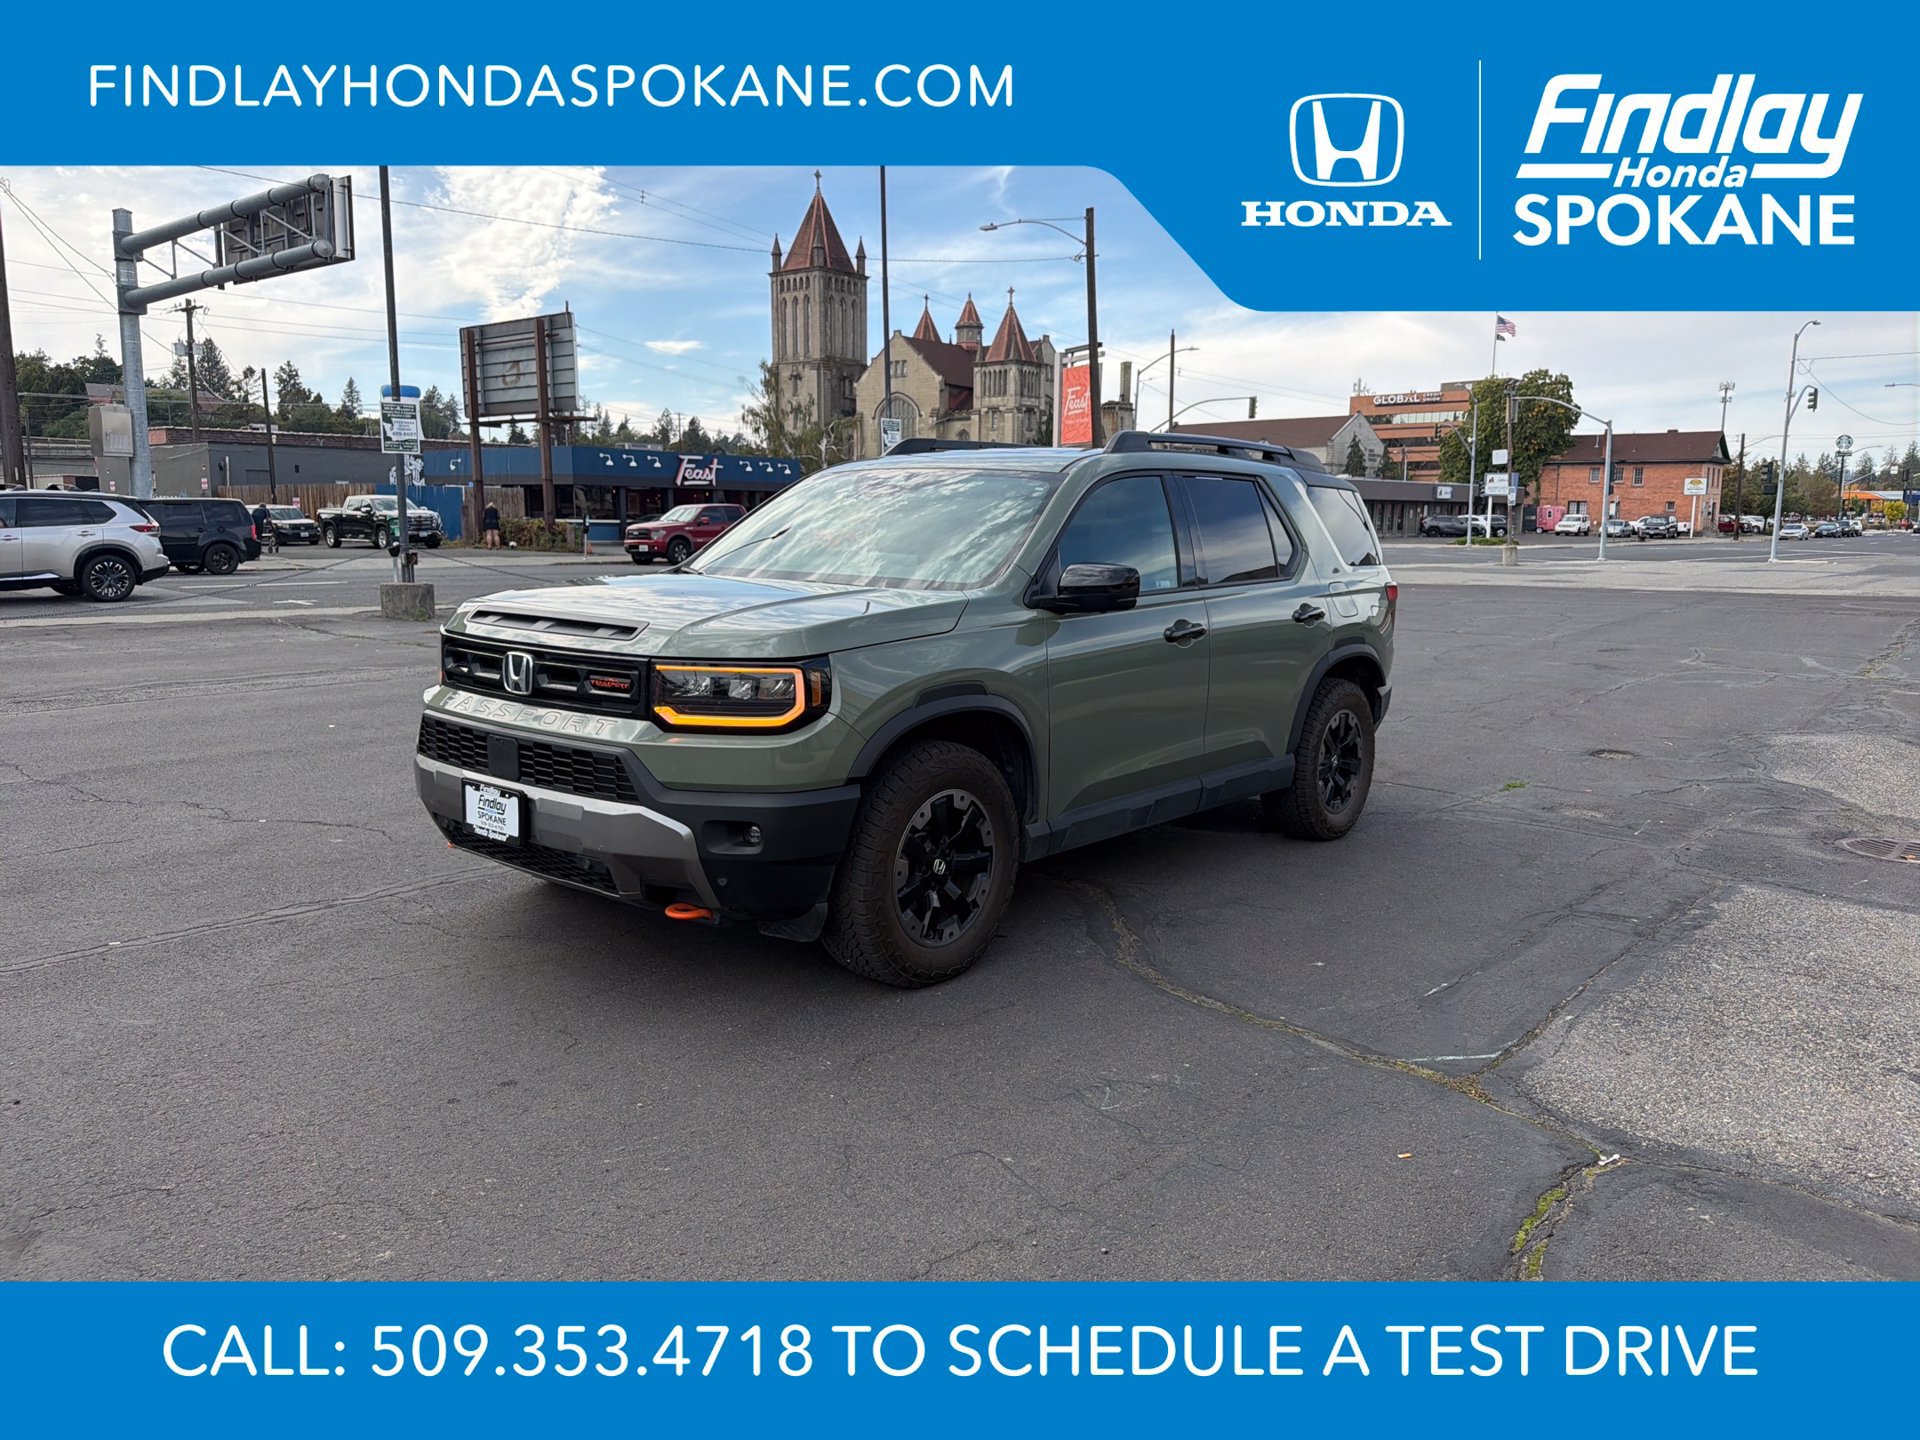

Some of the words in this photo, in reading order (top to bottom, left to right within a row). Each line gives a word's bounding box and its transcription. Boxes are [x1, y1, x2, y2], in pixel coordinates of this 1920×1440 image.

[1064, 387, 1090, 417] Feast
[1373, 394, 1420, 405] GLOBAL
[675, 454, 724, 487] Feast
[477, 794, 507, 816] Findlay
[477, 810, 507, 826] SPOKANE
